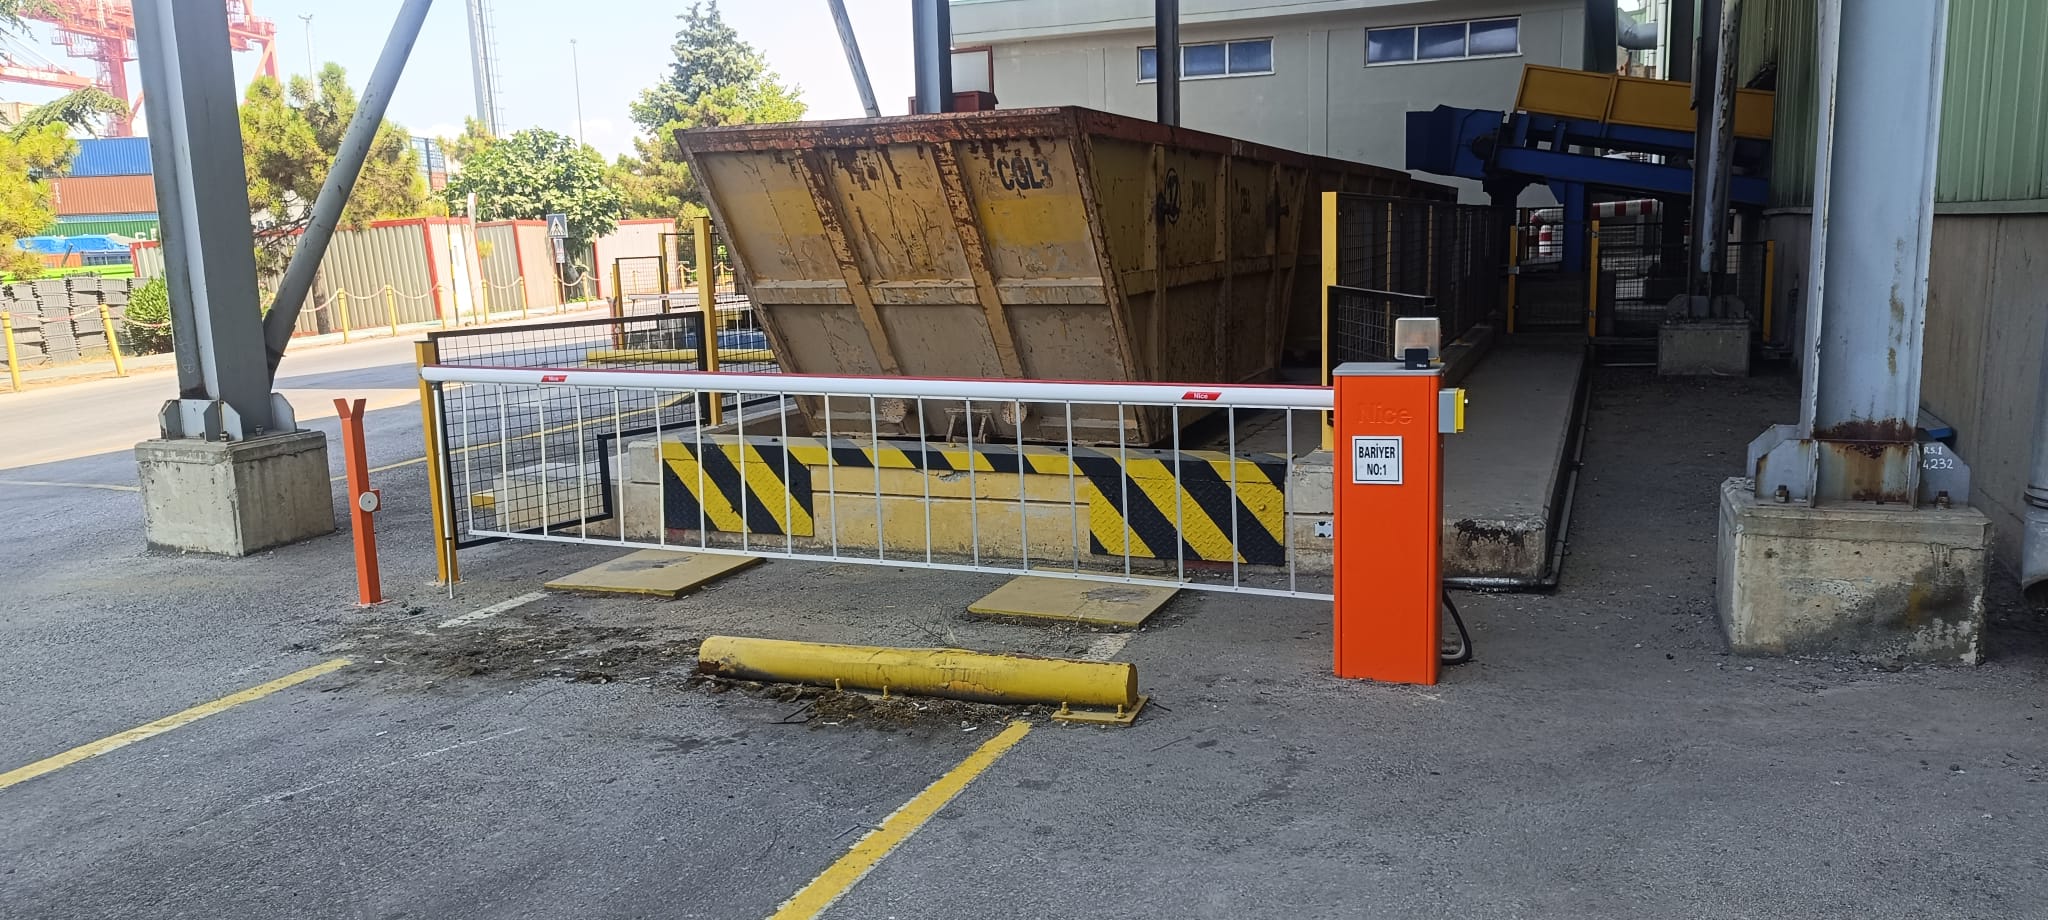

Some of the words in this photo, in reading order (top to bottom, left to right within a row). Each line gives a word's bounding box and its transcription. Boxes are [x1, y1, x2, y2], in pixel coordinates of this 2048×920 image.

[1358, 402, 1413, 425] Nice
[1358, 443, 1396, 459] BARİYER
[1367, 463, 1387, 476] NO:1
